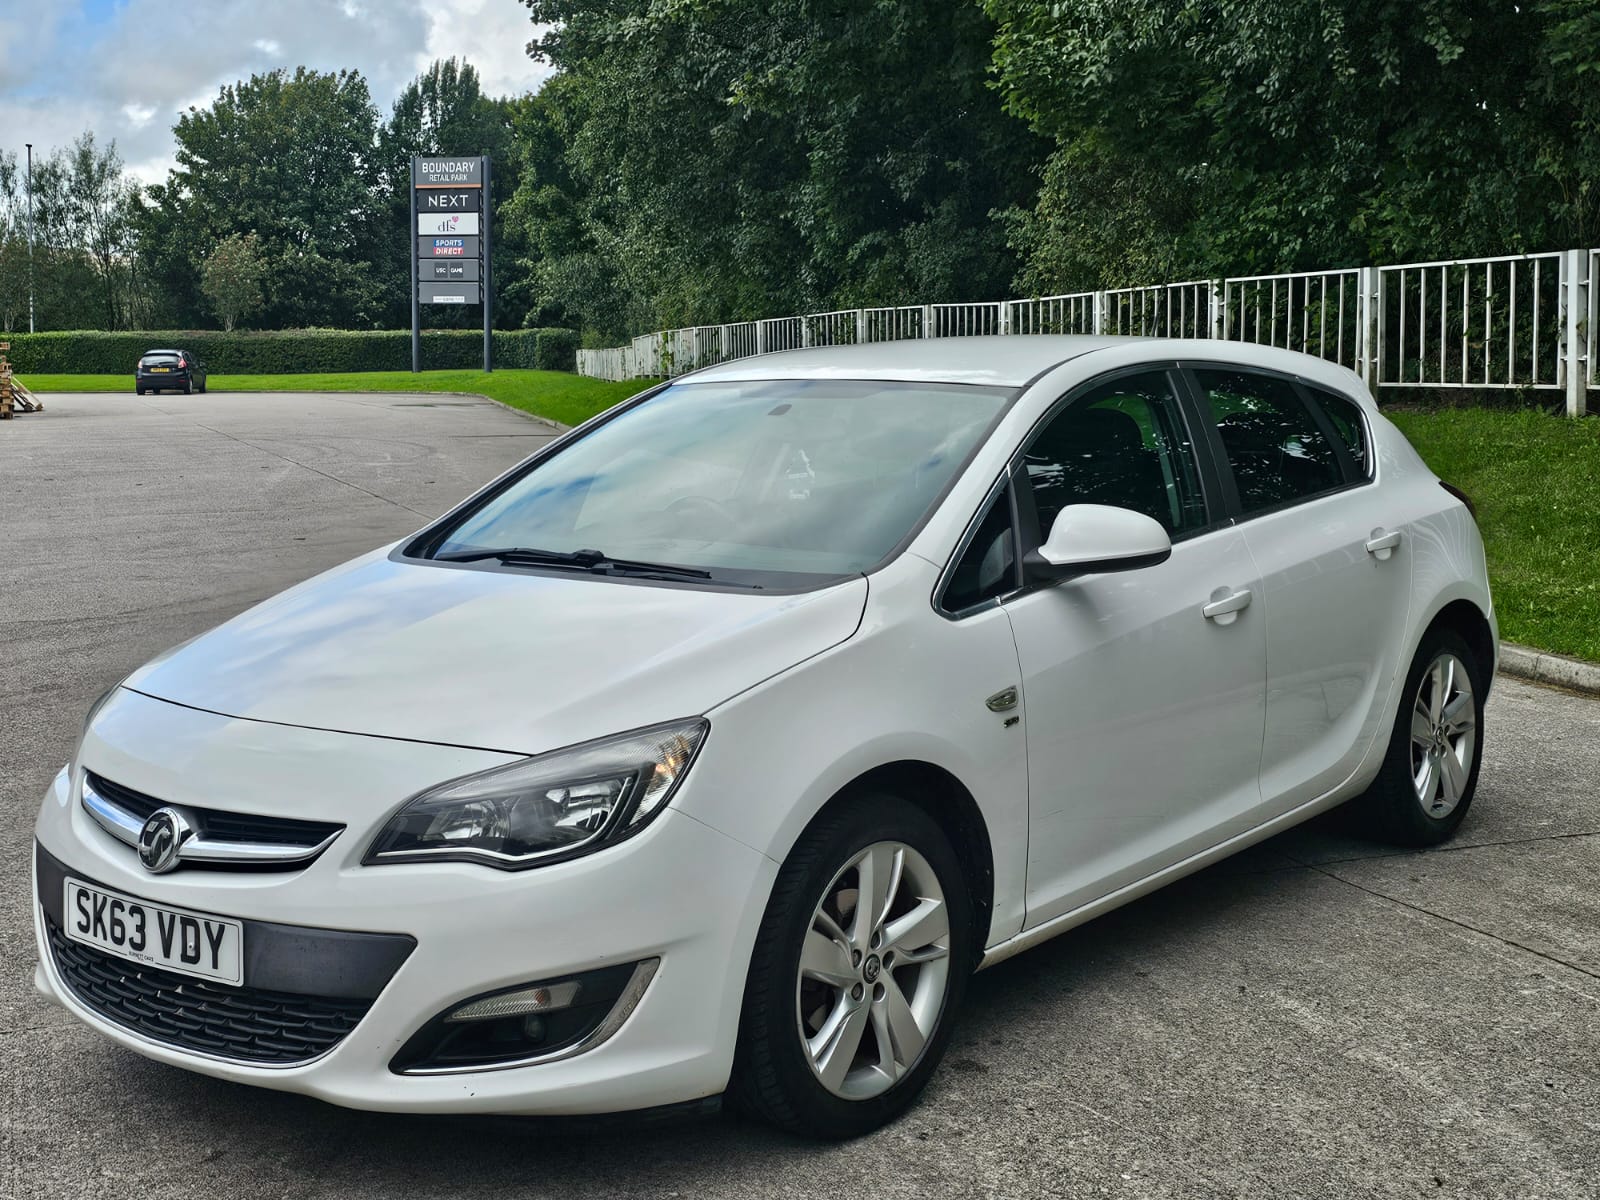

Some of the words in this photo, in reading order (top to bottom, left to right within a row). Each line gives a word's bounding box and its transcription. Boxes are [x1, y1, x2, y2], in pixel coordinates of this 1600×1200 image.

[422, 161, 475, 173] BOUNDARY
[429, 174, 449, 182] RETAIL
[450, 173, 468, 181] PARK
[428, 194, 469, 207] NEXT
[437, 219, 456, 232] dfs
[435, 239, 463, 247] SPORTS
[435, 247, 462, 255] DIRECT
[76, 888, 146, 952] SK63
[157, 911, 226, 970] VDY
